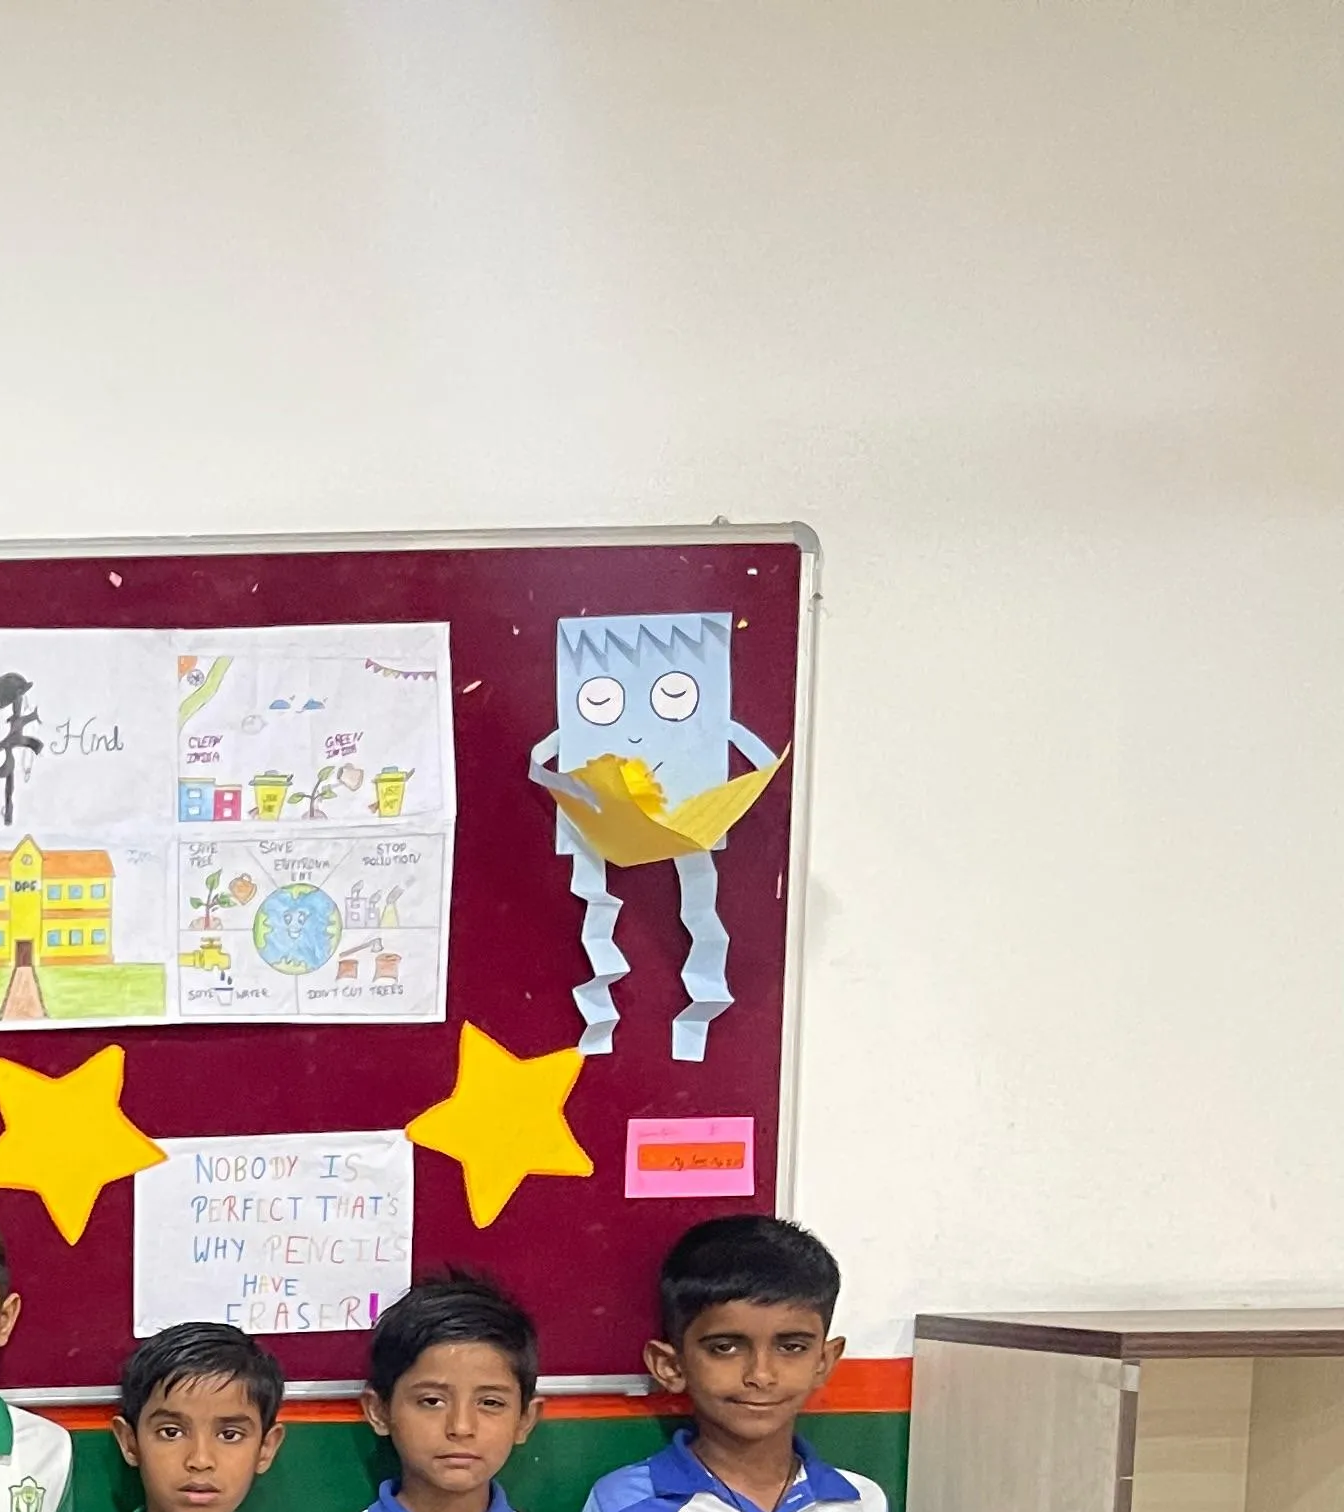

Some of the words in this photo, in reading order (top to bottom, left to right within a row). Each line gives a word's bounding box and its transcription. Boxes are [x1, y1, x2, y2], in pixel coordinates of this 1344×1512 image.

[258, 840, 294, 854] SAVE
[376, 842, 407, 855] STOP
[195, 1154, 299, 1184] NOBODY
[319, 1153, 362, 1183] IS
[190, 1195, 303, 1224] PERFECT
[315, 1191, 400, 1222] THAT'S
[193, 1235, 246, 1264] WHY
[242, 1273, 300, 1298] HAVE
